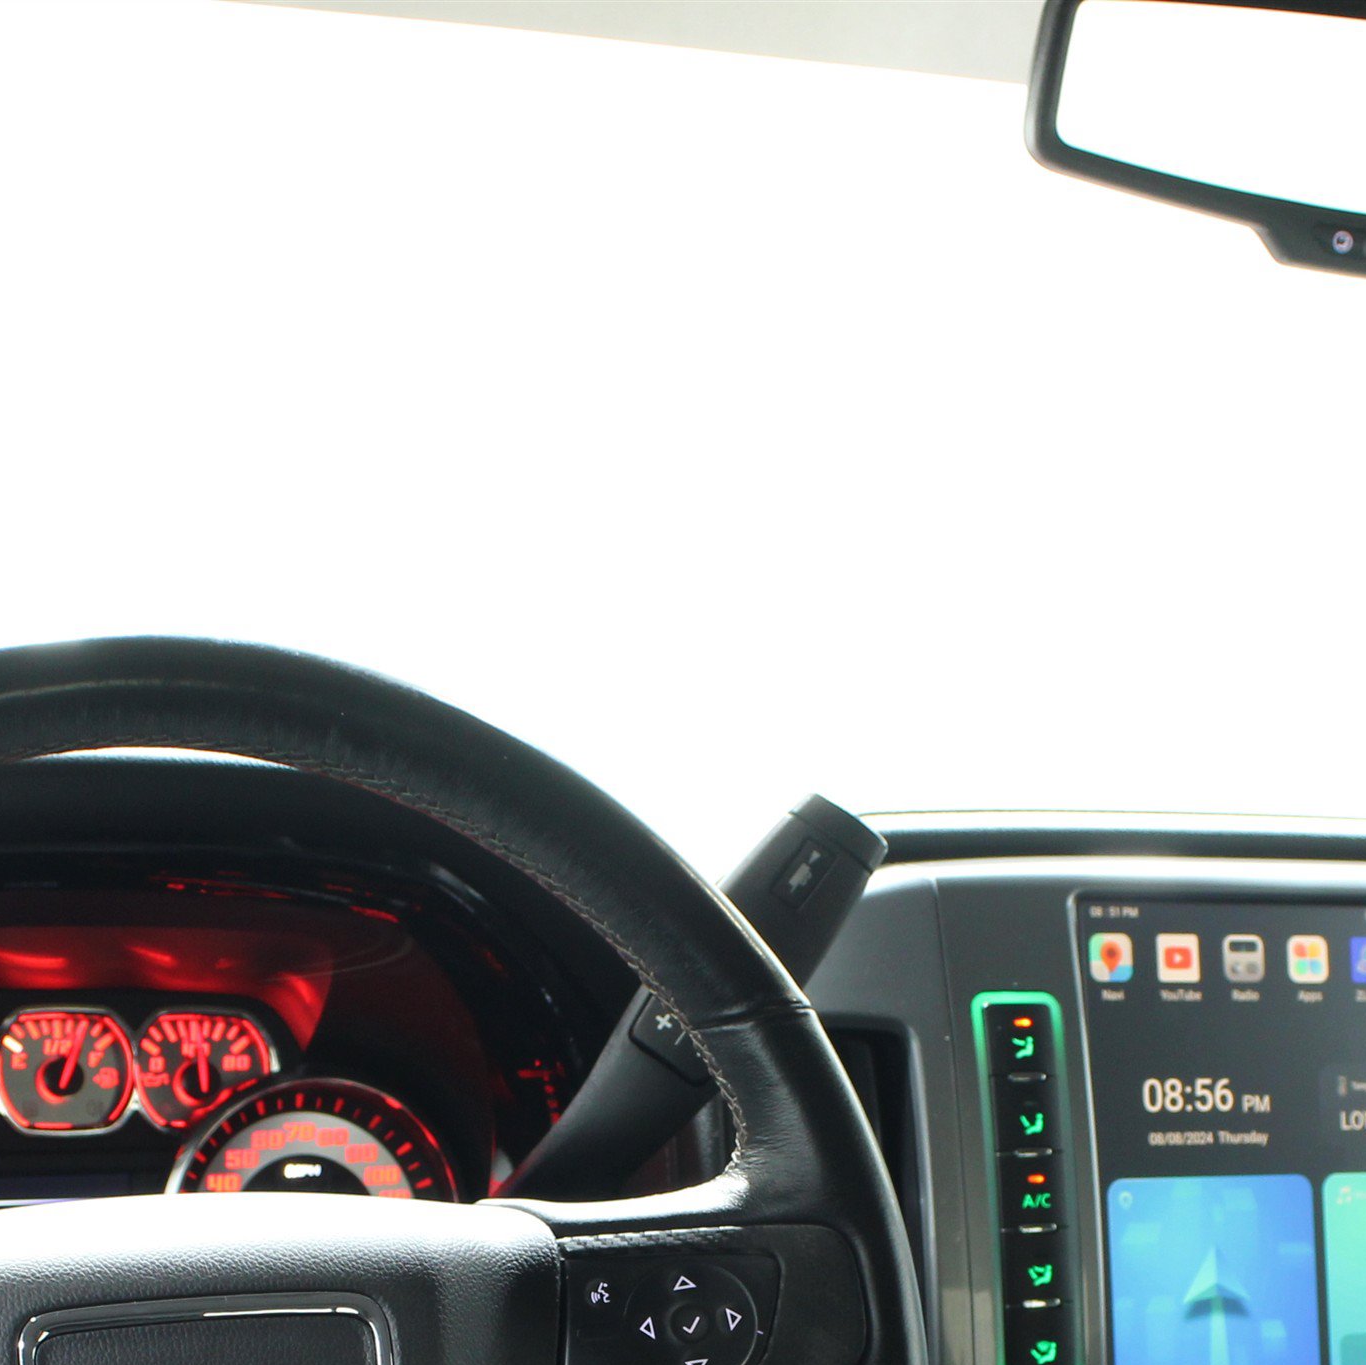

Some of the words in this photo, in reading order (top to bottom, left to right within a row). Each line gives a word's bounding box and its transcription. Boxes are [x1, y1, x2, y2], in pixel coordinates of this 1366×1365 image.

[1101, 988, 1125, 1001] Navi
[1159, 988, 1203, 1001] YouTube
[1231, 988, 1260, 1001] Radio
[1297, 990, 1323, 1003] Apps
[1142, 1077, 1234, 1113] 08:56
[1241, 1094, 1271, 1113] PM
[282, 1121, 317, 1143] 70
[1218, 1129, 1269, 1147] Thursday
[224, 1148, 261, 1170] 50
[205, 1172, 243, 1192] 40
[363, 1165, 402, 1187] 100
[1021, 1192, 1052, 1209] A/C
